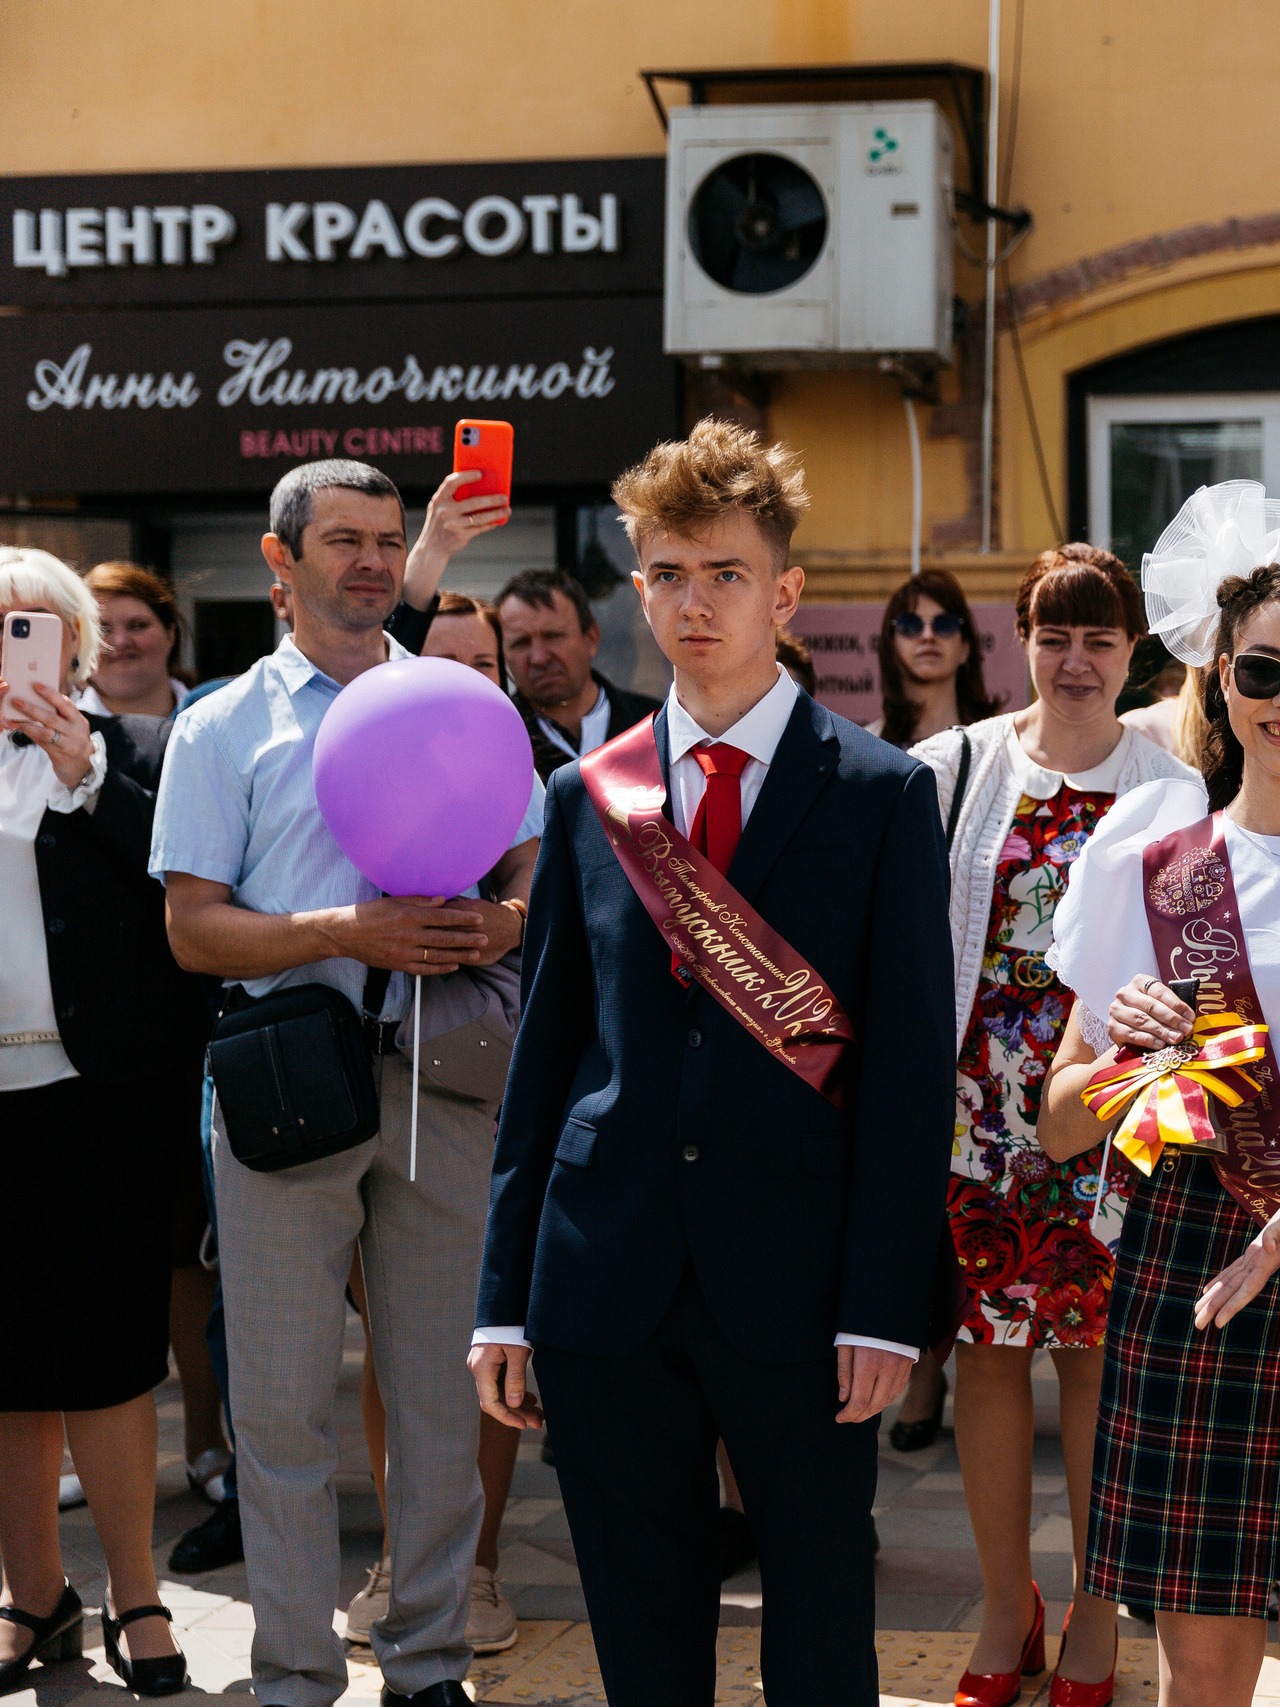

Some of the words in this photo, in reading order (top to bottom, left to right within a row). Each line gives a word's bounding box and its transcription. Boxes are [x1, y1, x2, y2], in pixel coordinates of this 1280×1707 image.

[13, 203, 236, 277] ЦЕНТР
[265, 194, 619, 262] КРАСОТЫ
[27, 342, 200, 411] Анны
[217, 336, 616, 407] Ниточкиной
[240, 429, 340, 458] BEAUTY
[343, 426, 445, 455] CENTRE
[633, 821, 765, 991] Выпускник
[668, 857, 727, 912] Тимофеев
[719, 910, 787, 981] Константин
